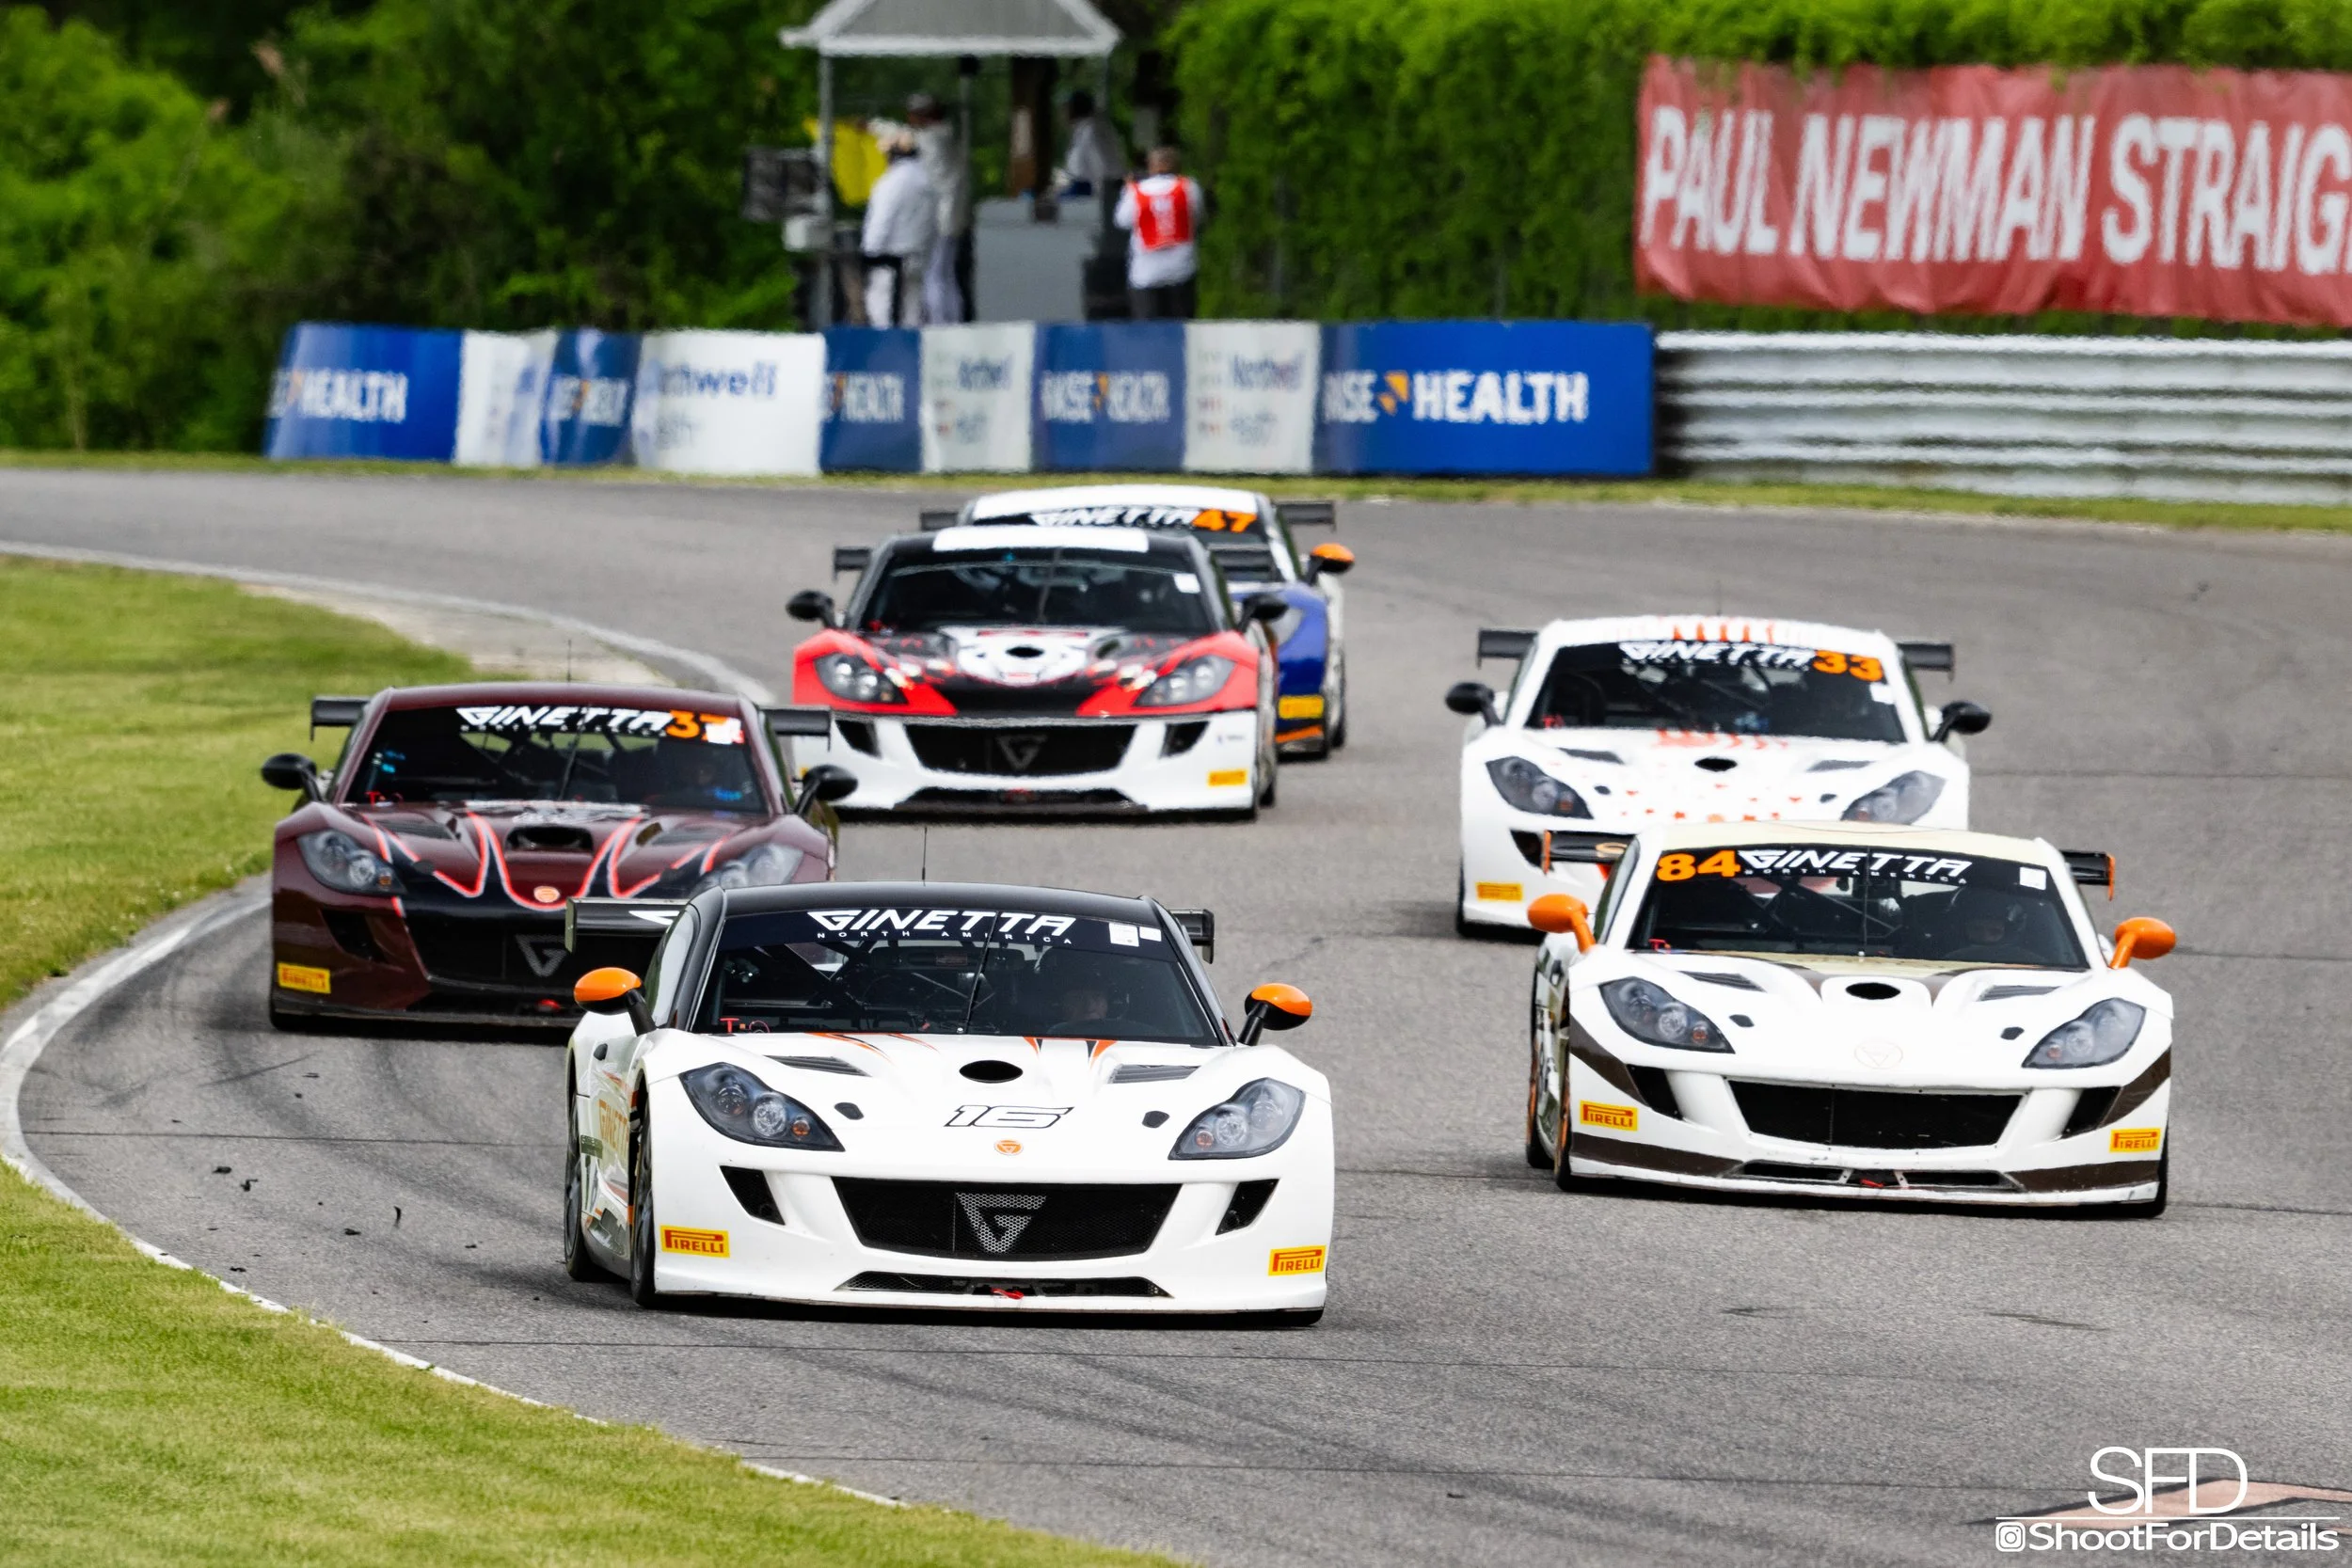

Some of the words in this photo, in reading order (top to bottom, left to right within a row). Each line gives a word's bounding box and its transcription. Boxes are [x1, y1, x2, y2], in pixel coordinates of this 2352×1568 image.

[1640, 104, 1778, 255] PAUL
[1790, 114, 2096, 263] NEWMAN
[2101, 113, 2352, 277] STRAIG
[1413, 368, 1590, 424] HEALTH
[1192, 508, 1258, 532] 47
[1812, 649, 1884, 681] 33
[456, 705, 675, 731] GINETTA
[1656, 849, 1740, 881] 84
[1738, 849, 1973, 878] GINETTA
[807, 909, 1077, 936] GINETTA
[817, 930, 911, 939] NORTH
[1583, 1104, 1634, 1128] PIRELLI
[2113, 1132, 2157, 1148] PIRELLI
[664, 1229, 723, 1253] PIRELLI
[1272, 1249, 1323, 1273] PIRELLI
